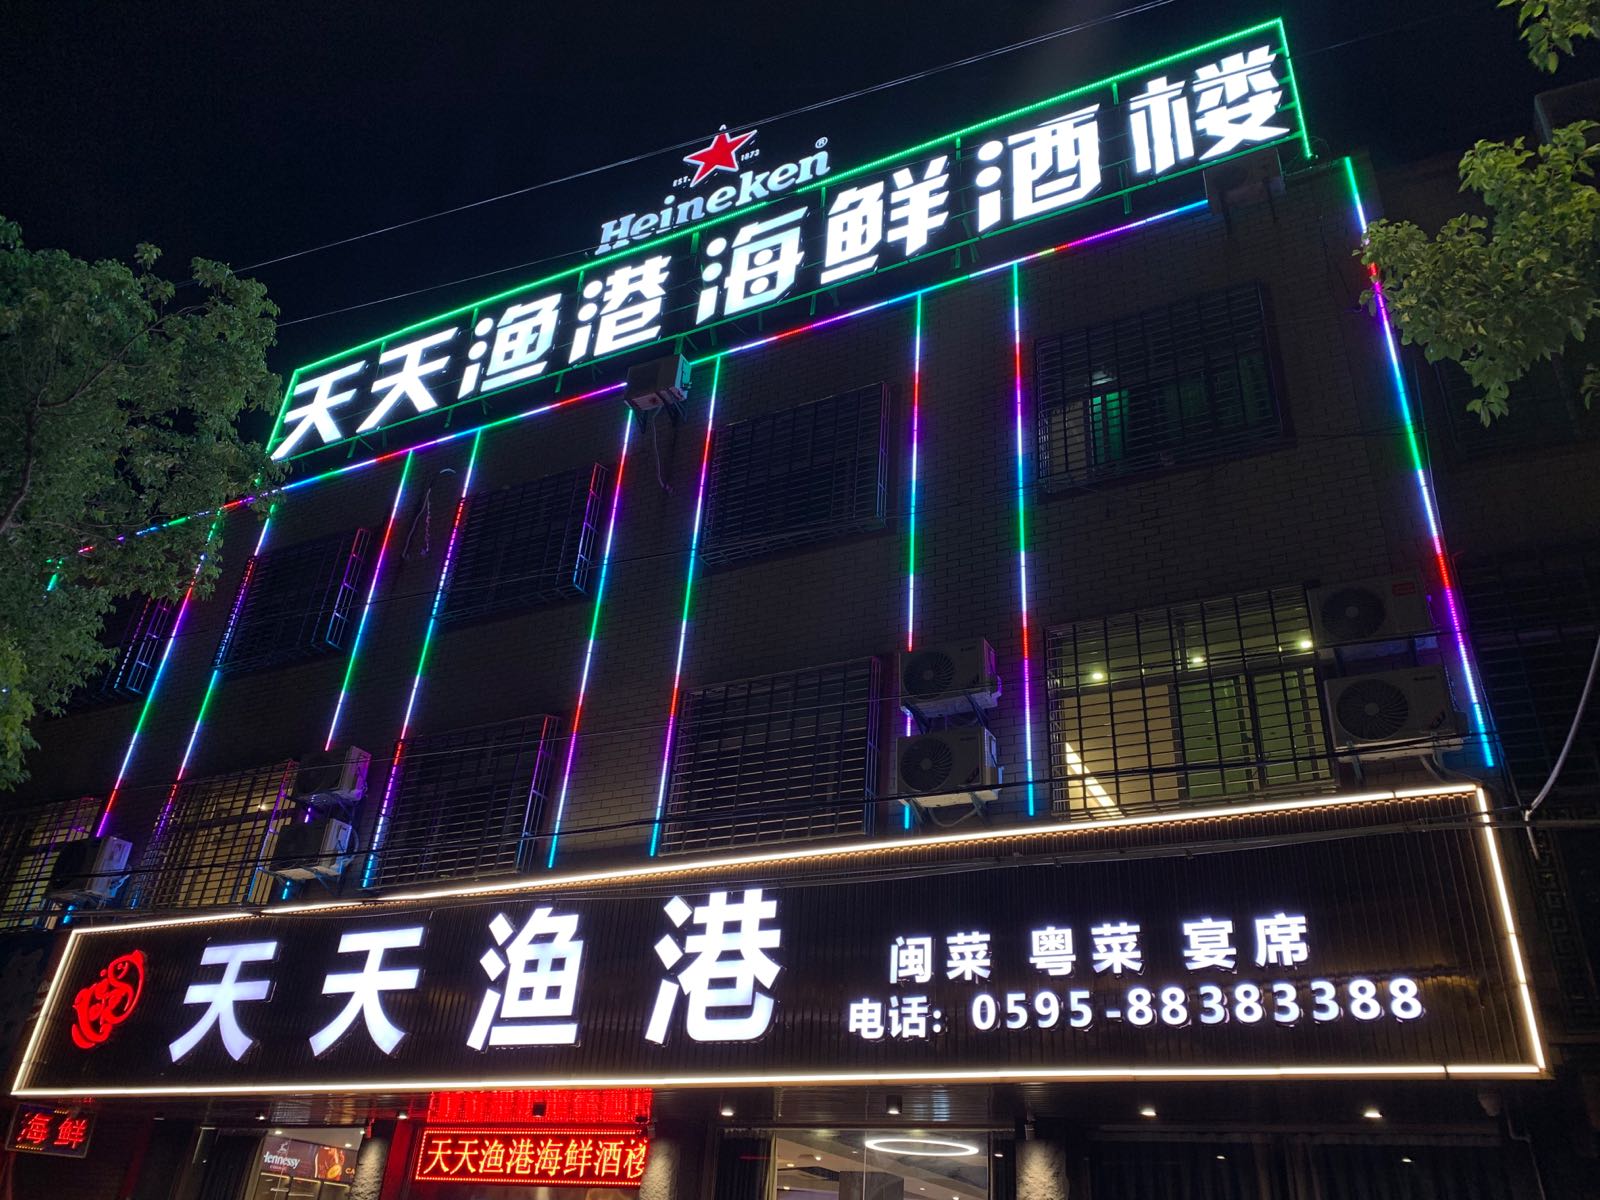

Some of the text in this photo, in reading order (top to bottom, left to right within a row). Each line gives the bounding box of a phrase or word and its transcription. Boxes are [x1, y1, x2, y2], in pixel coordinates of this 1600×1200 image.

[595, 150, 831, 255] Heineken
[271, 45, 1290, 461] 天天渔港海鲜酒楼
[889, 912, 1310, 984] 闽菜 粤菜 宴席
[971, 976, 1424, 1031] 0595-88383388
[17, 1112, 87, 1150] 海鲜
